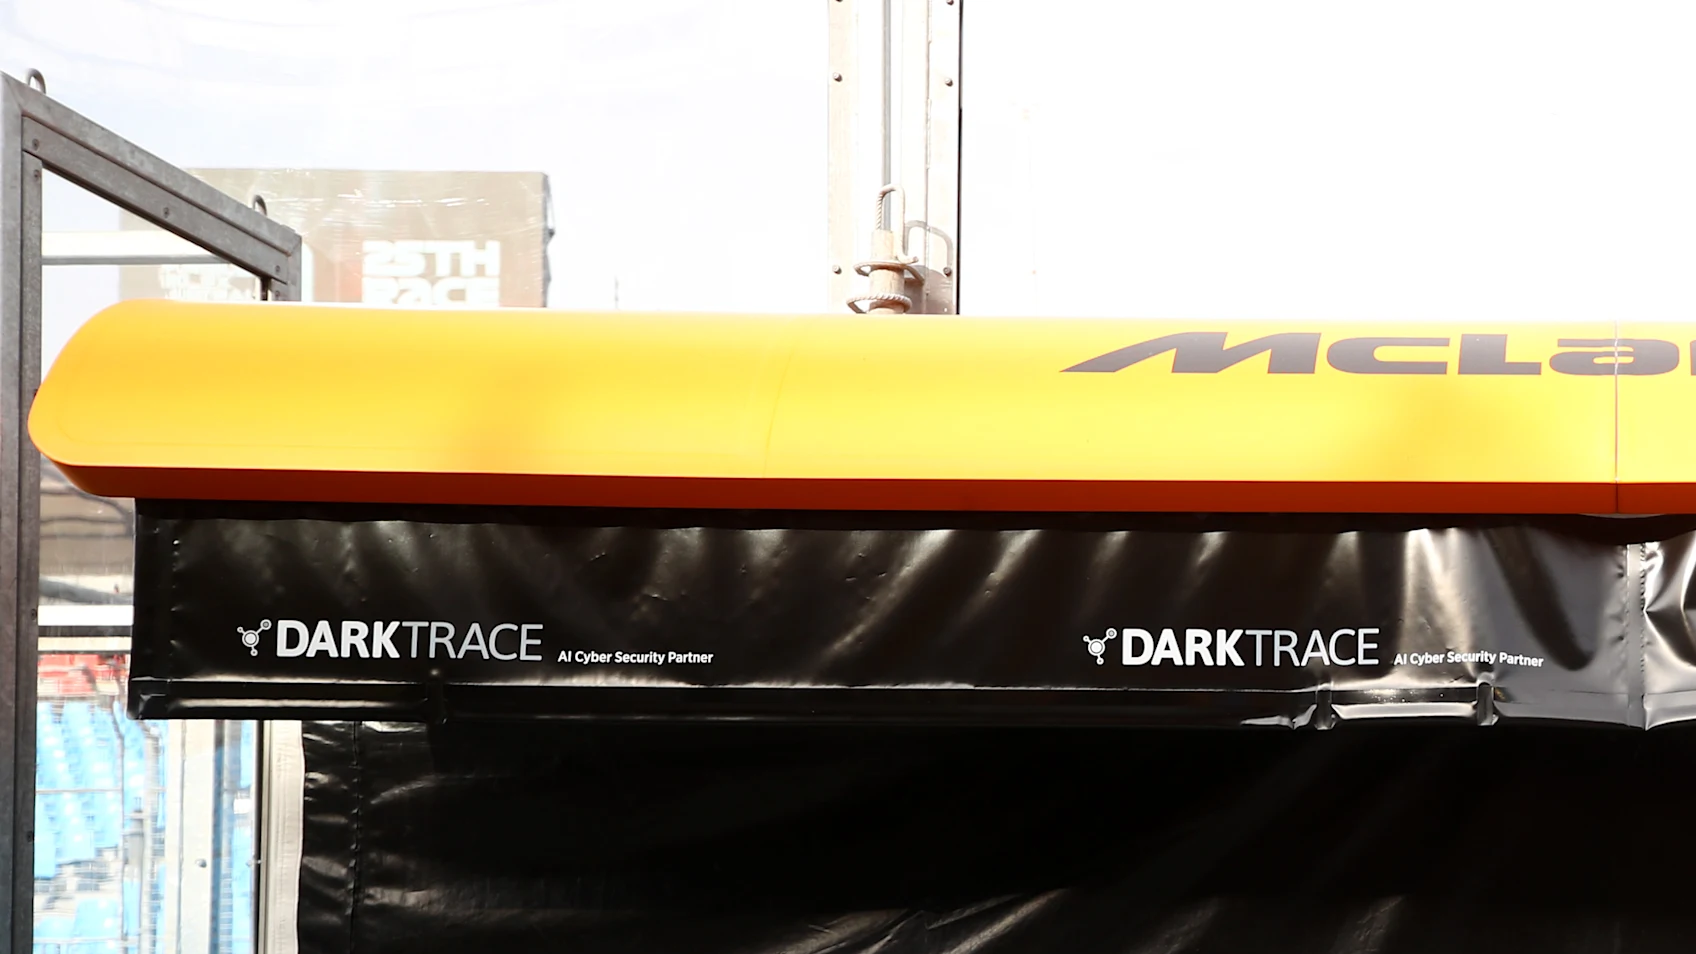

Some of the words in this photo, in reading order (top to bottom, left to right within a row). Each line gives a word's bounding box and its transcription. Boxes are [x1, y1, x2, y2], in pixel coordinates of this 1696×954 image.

[362, 239, 500, 277] 25TH
[275, 619, 543, 661] DARKTRACE
[557, 650, 572, 663] AI
[574, 651, 613, 665] Cyber
[614, 651, 666, 665] Security
[667, 651, 714, 665] Partner
[1121, 627, 1380, 666] DARKTRACE
[1394, 653, 1407, 666] AI
[1409, 652, 1445, 666] Cyber
[1446, 650, 1497, 664] Security
[1498, 652, 1544, 667] Partner
